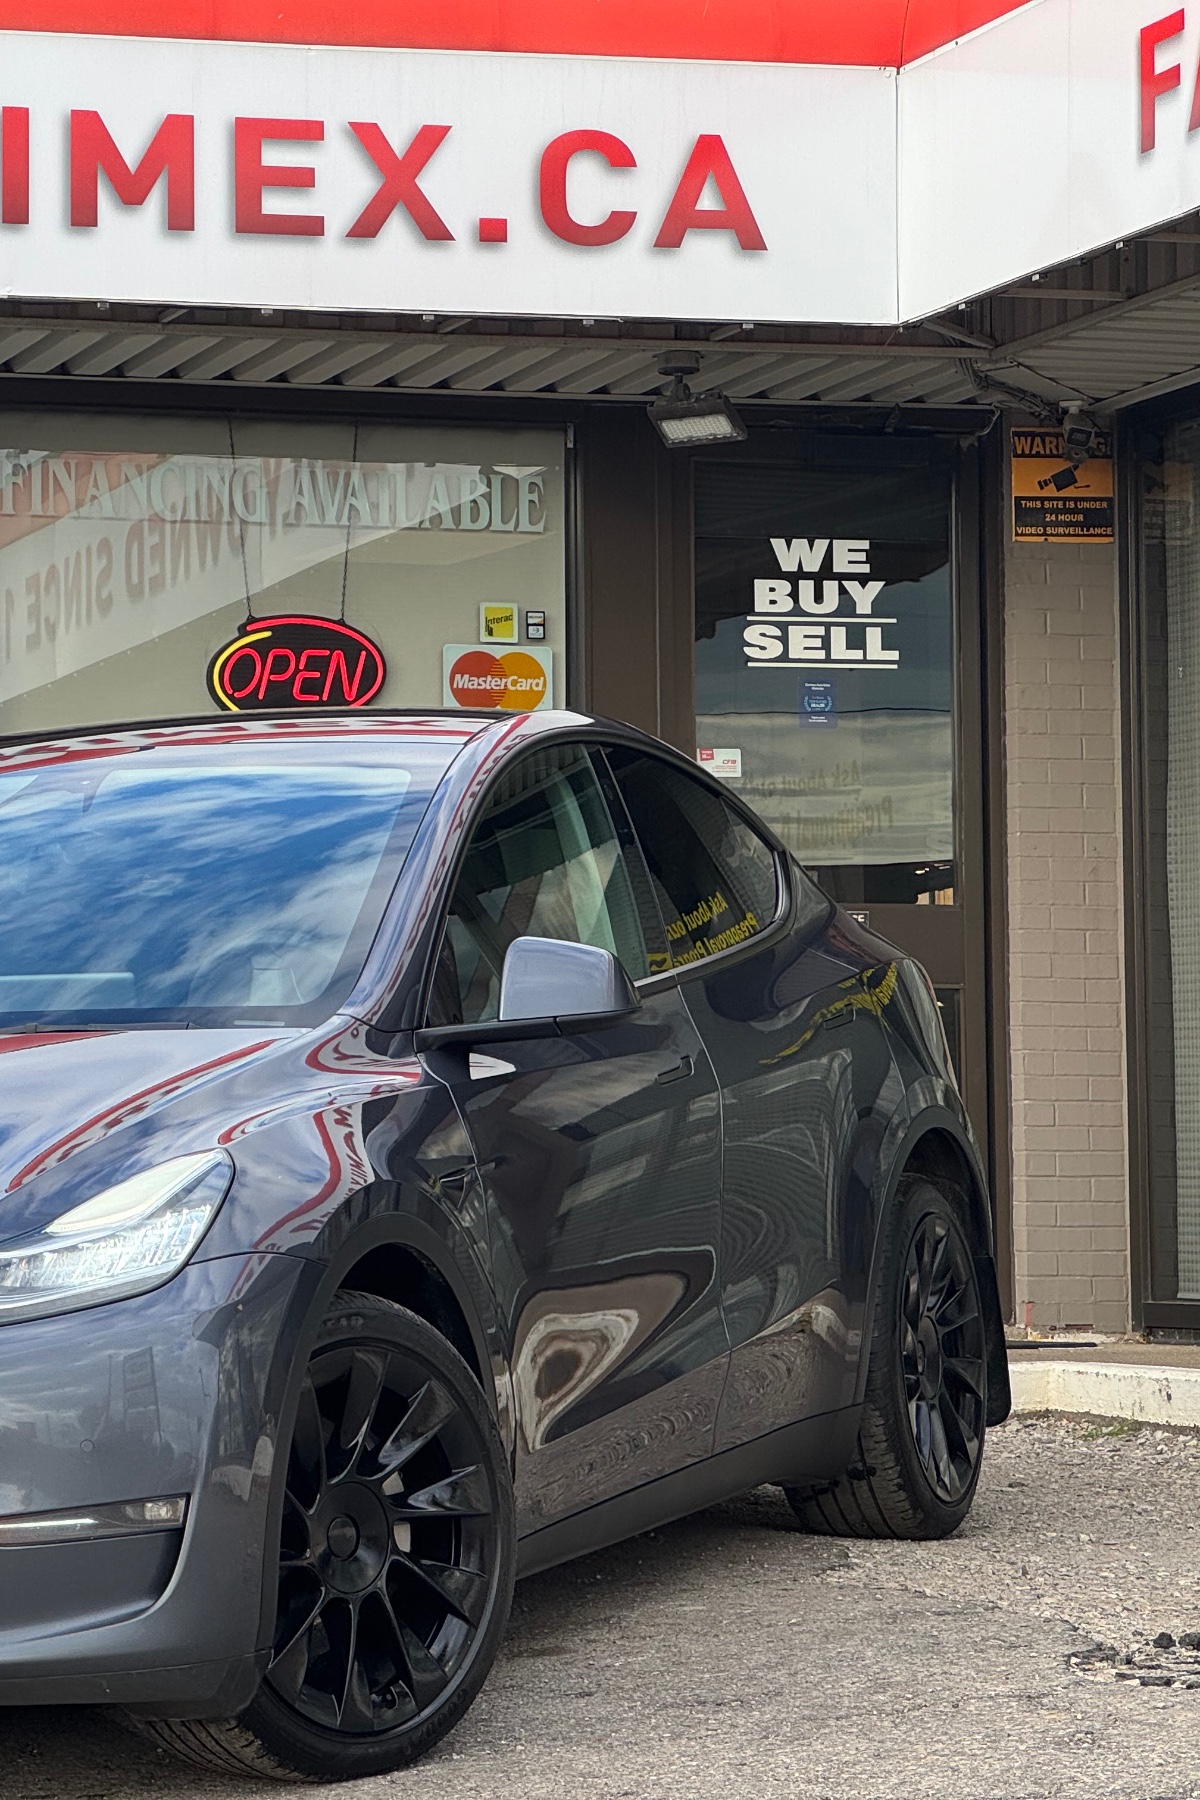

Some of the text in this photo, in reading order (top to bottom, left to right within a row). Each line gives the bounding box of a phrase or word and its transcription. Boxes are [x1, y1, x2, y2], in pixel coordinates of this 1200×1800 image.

[1013, 436, 1112, 456] WARNG!
[0, 457, 268, 525] FINANCING
[285, 466, 547, 533] AVAILABLE
[1020, 500, 1108, 509] THIS SITE IS UNDER
[1044, 513, 1084, 522] 24 HOUR
[1016, 526, 1113, 535] VIDEO SURVEILLANCE
[769, 537, 871, 574] WE
[753, 578, 887, 615] BUY
[485, 613, 514, 626] Interac
[742, 624, 900, 661] SELL
[223, 647, 367, 702] OPEN
[453, 673, 545, 691] MasterCard
